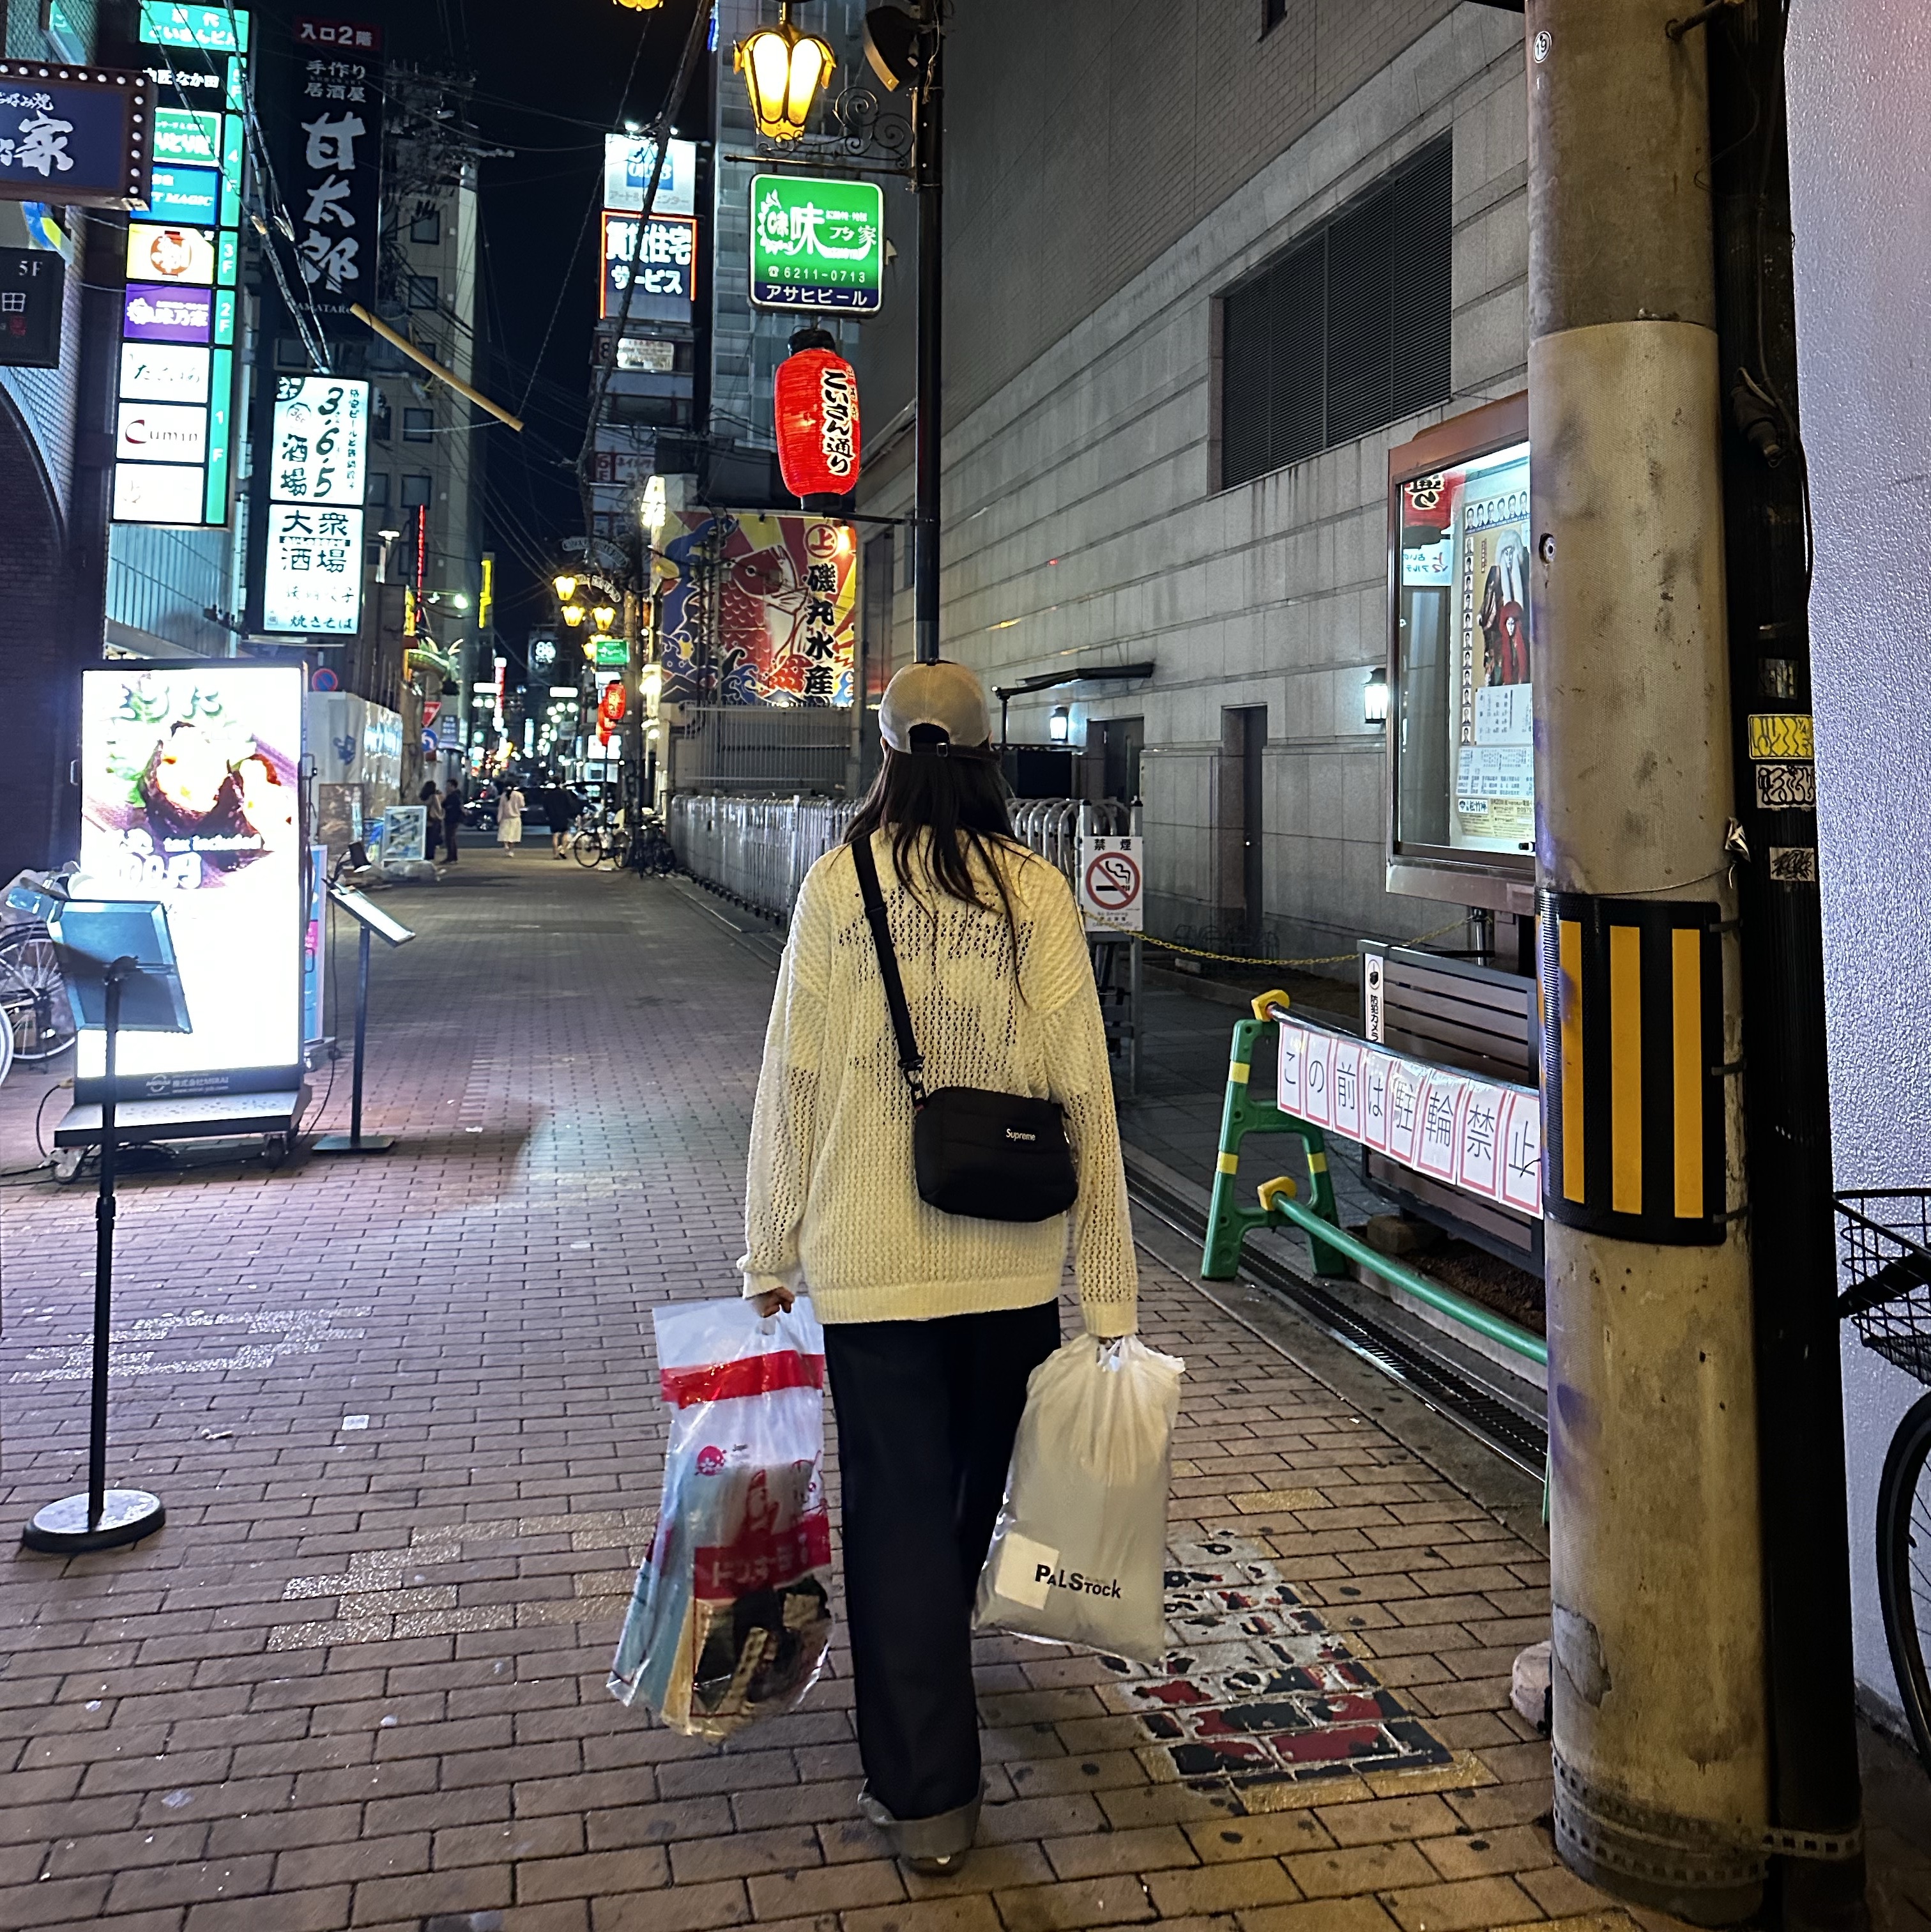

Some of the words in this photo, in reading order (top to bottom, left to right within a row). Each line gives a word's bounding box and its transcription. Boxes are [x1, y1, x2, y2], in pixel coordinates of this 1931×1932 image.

[301, 23, 372, 47] 入口2階
[1536, 38, 1546, 56] 19
[306, 59, 366, 80] 手作り
[304, 82, 367, 103] 居酒屋
[299, 111, 367, 294] 甘太郎
[19, 260, 43, 277] 5F
[221, 243, 234, 275] 3F
[611, 265, 683, 295] サービス
[784, 266, 866, 283] 6211-0713
[766, 284, 868, 306] アサヒビール
[218, 302, 231, 334] 2F
[280, 433, 308, 496] 酒場
[282, 509, 349, 536] 大衆
[810, 528, 834, 551] 上
[281, 548, 347, 573] 酒場
[804, 563, 836, 695] 磯丸水産
[192, 833, 262, 851] included
[1094, 839, 1132, 851] 禁煙
[1285, 1050, 1536, 1177] この前は駐輪禁止
[1006, 1128, 1036, 1142] Supreme
